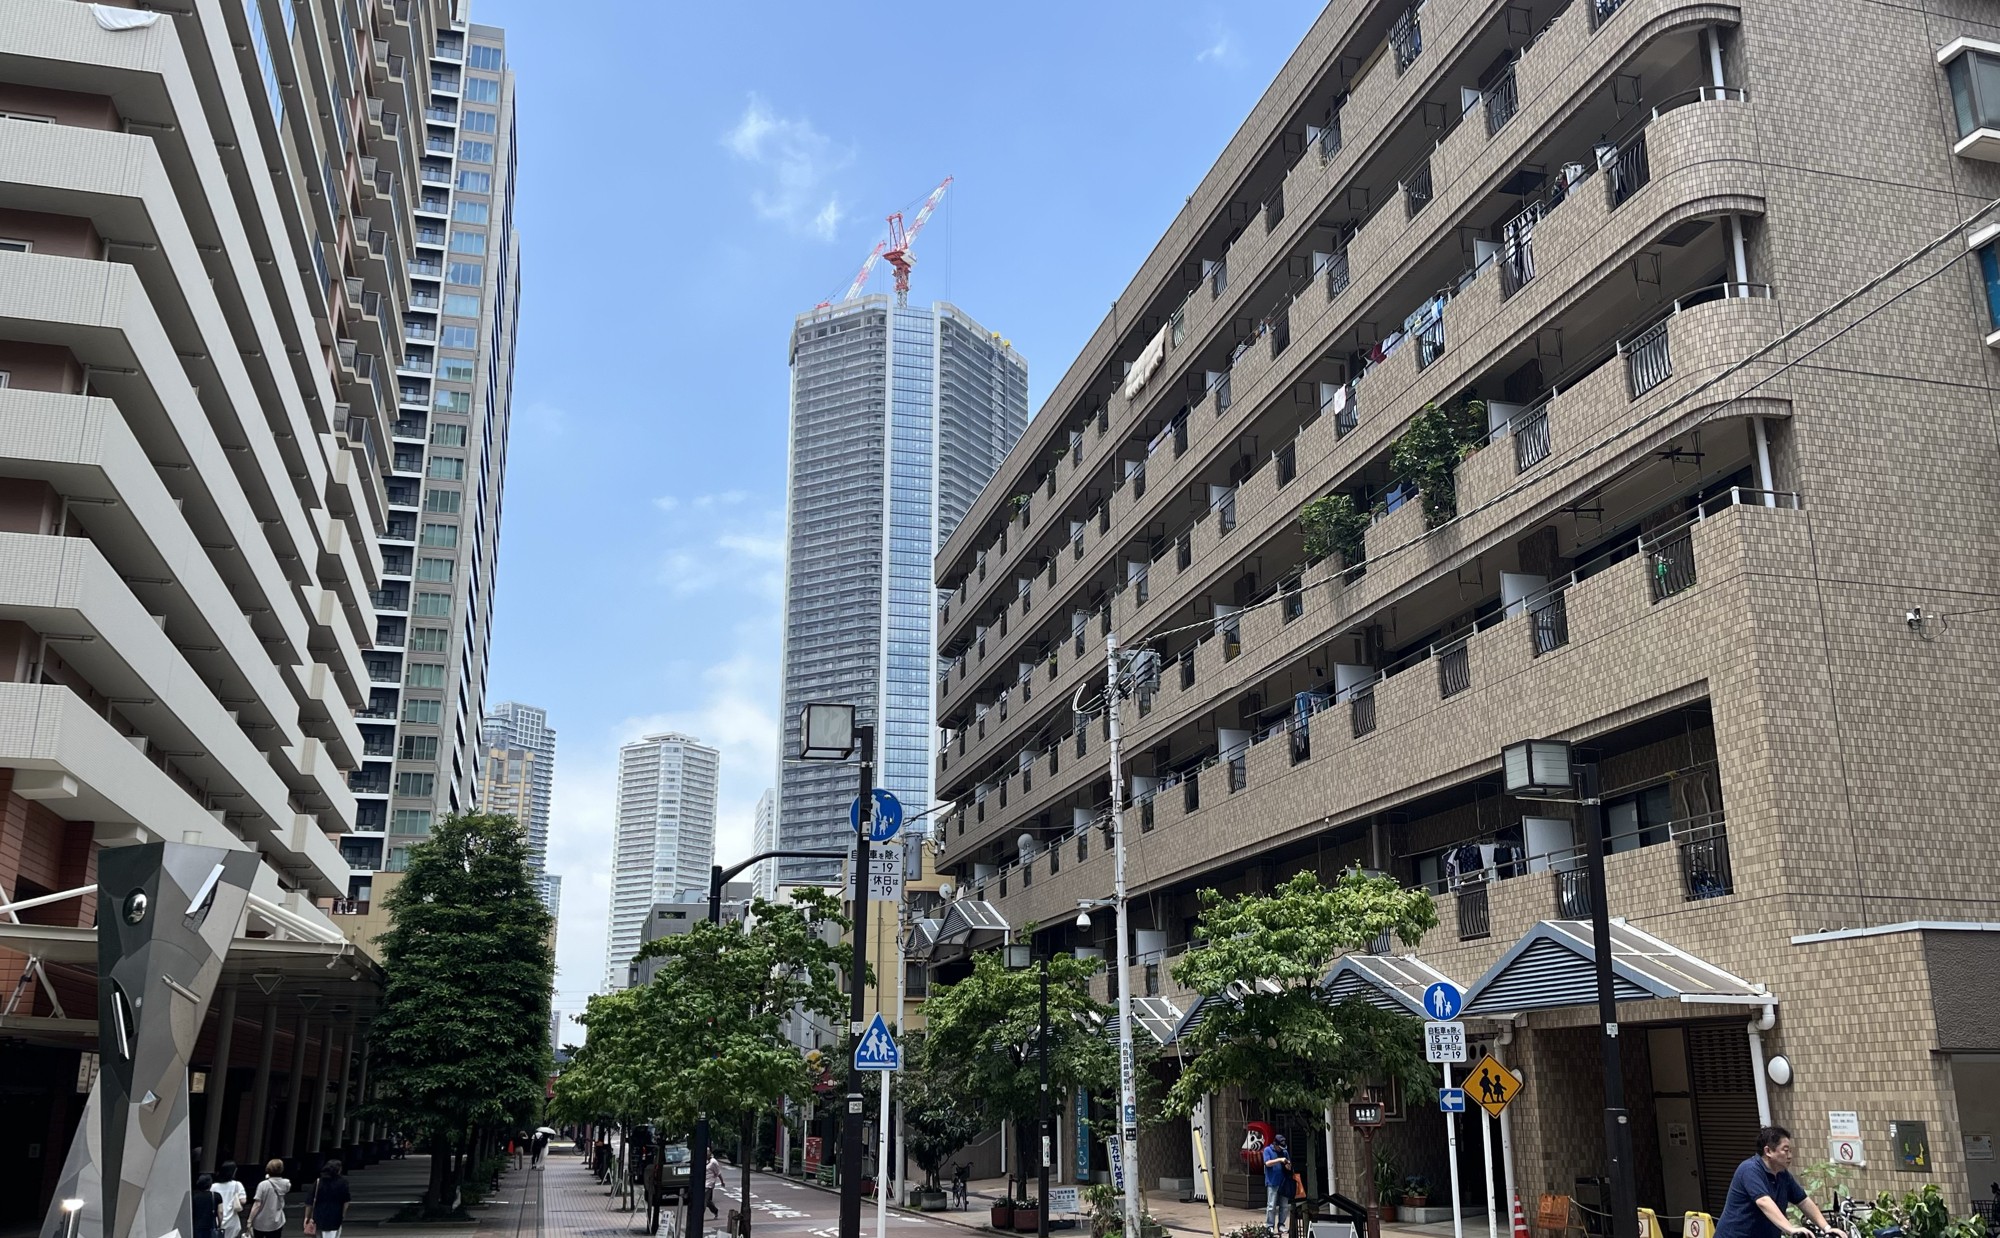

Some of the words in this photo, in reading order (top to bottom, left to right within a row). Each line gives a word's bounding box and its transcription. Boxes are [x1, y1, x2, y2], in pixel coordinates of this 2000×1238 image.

[852, 850, 899, 860] 自車を除く
[1110, 1136, 1124, 1188] 処方せん受付
